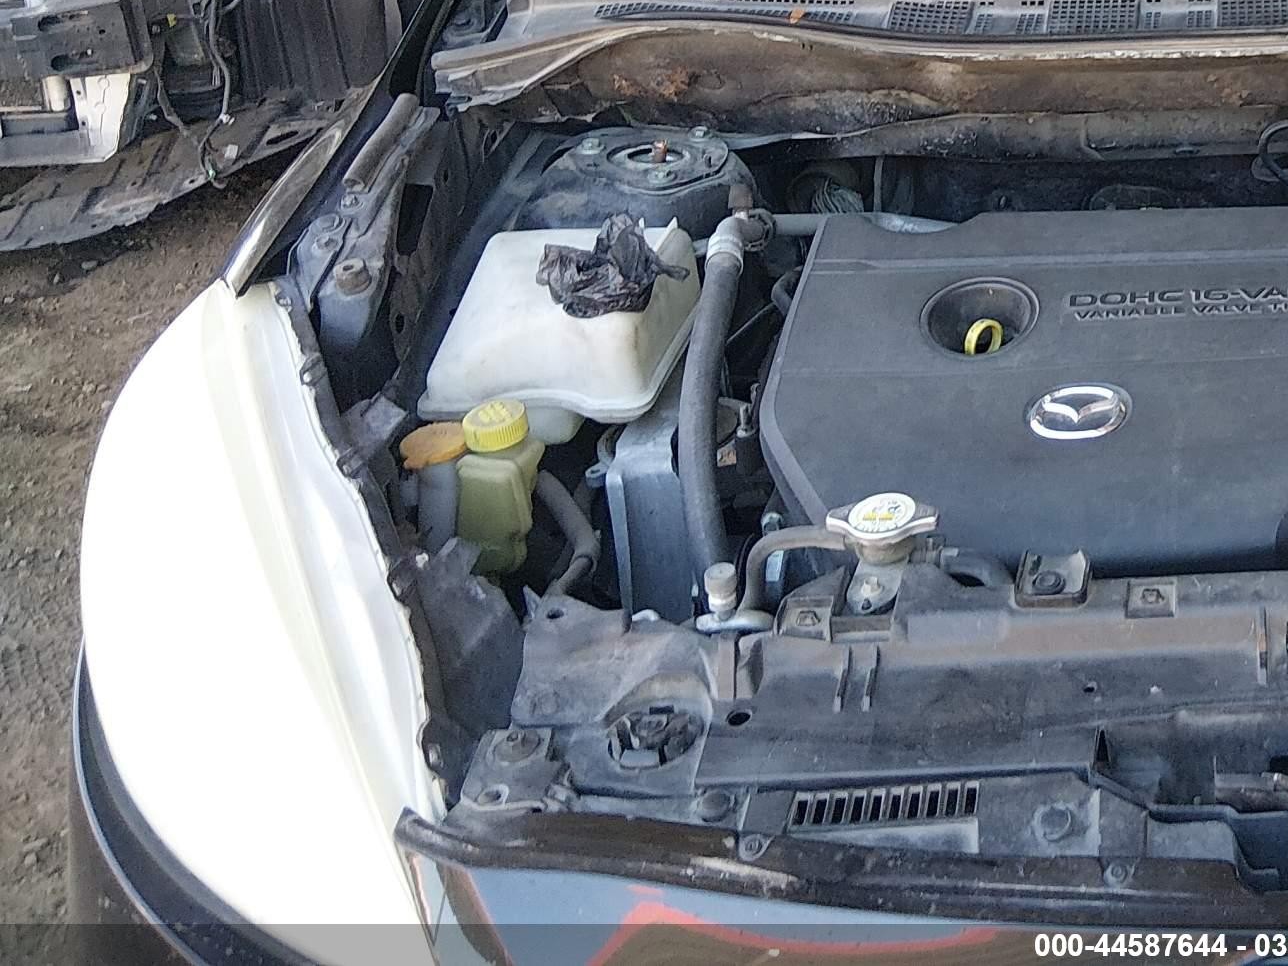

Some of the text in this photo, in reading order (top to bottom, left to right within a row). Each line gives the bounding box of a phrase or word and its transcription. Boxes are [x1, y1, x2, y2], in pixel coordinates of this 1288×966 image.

[1069, 289, 1185, 307] DOHC
[1074, 305, 1186, 321] VARIABLE
[1192, 303, 1263, 316] VALVE
